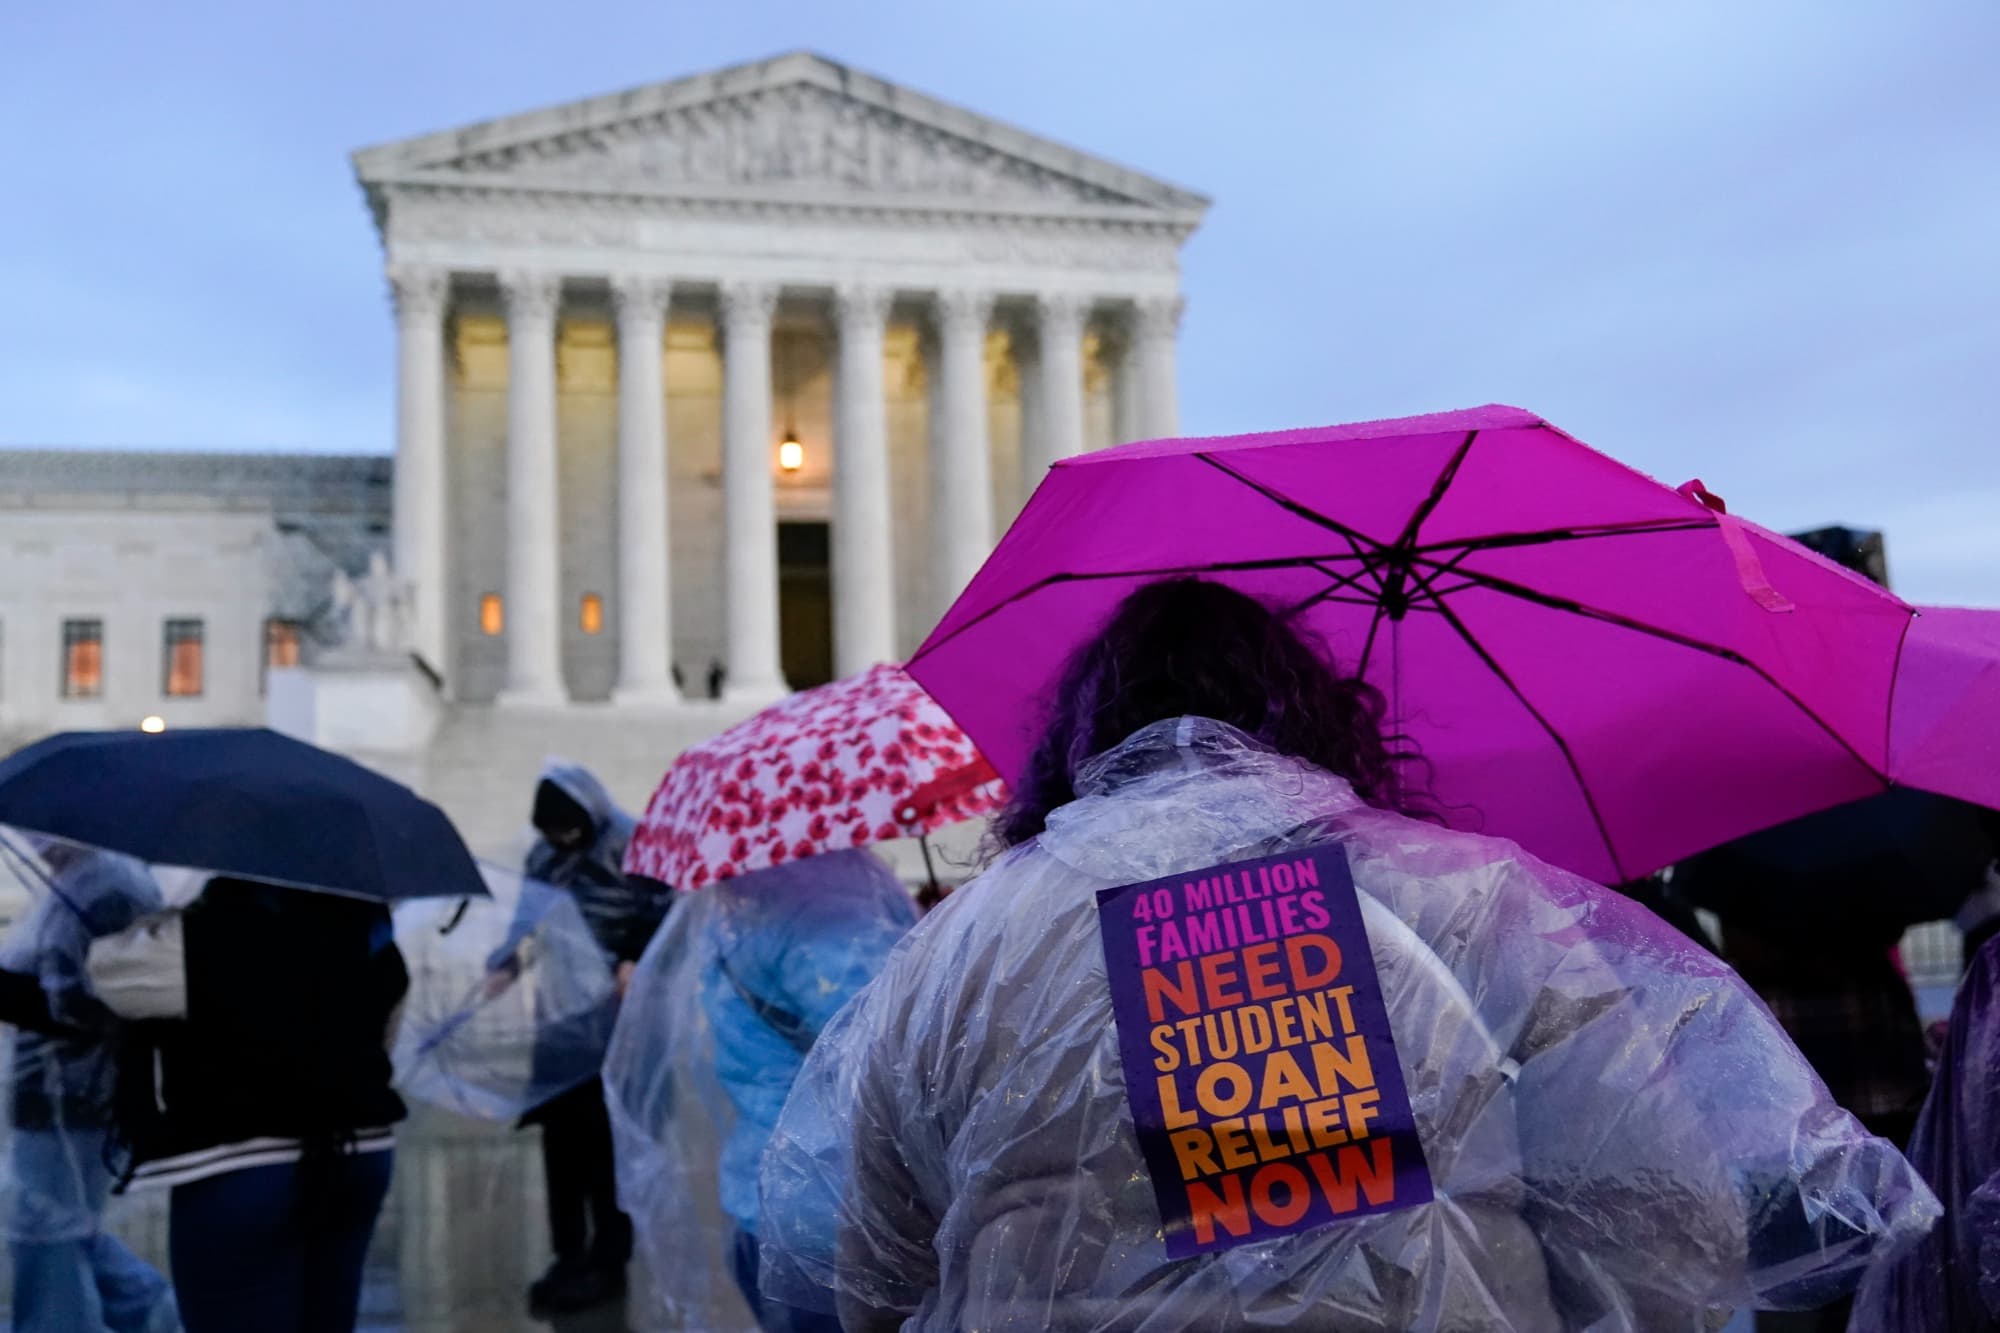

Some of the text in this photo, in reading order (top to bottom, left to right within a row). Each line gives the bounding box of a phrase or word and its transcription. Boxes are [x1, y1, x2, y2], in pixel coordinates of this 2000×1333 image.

[1134, 859, 1319, 922] 40 MILLION
[1137, 891, 1330, 966] FAMILIES
[1142, 934, 1342, 1022] NEED
[1151, 985, 1356, 1072] STUDENT
[1157, 1035, 1375, 1129] LOAN
[1170, 1090, 1380, 1180] RELIEF
[1186, 1137, 1395, 1244] NOW
